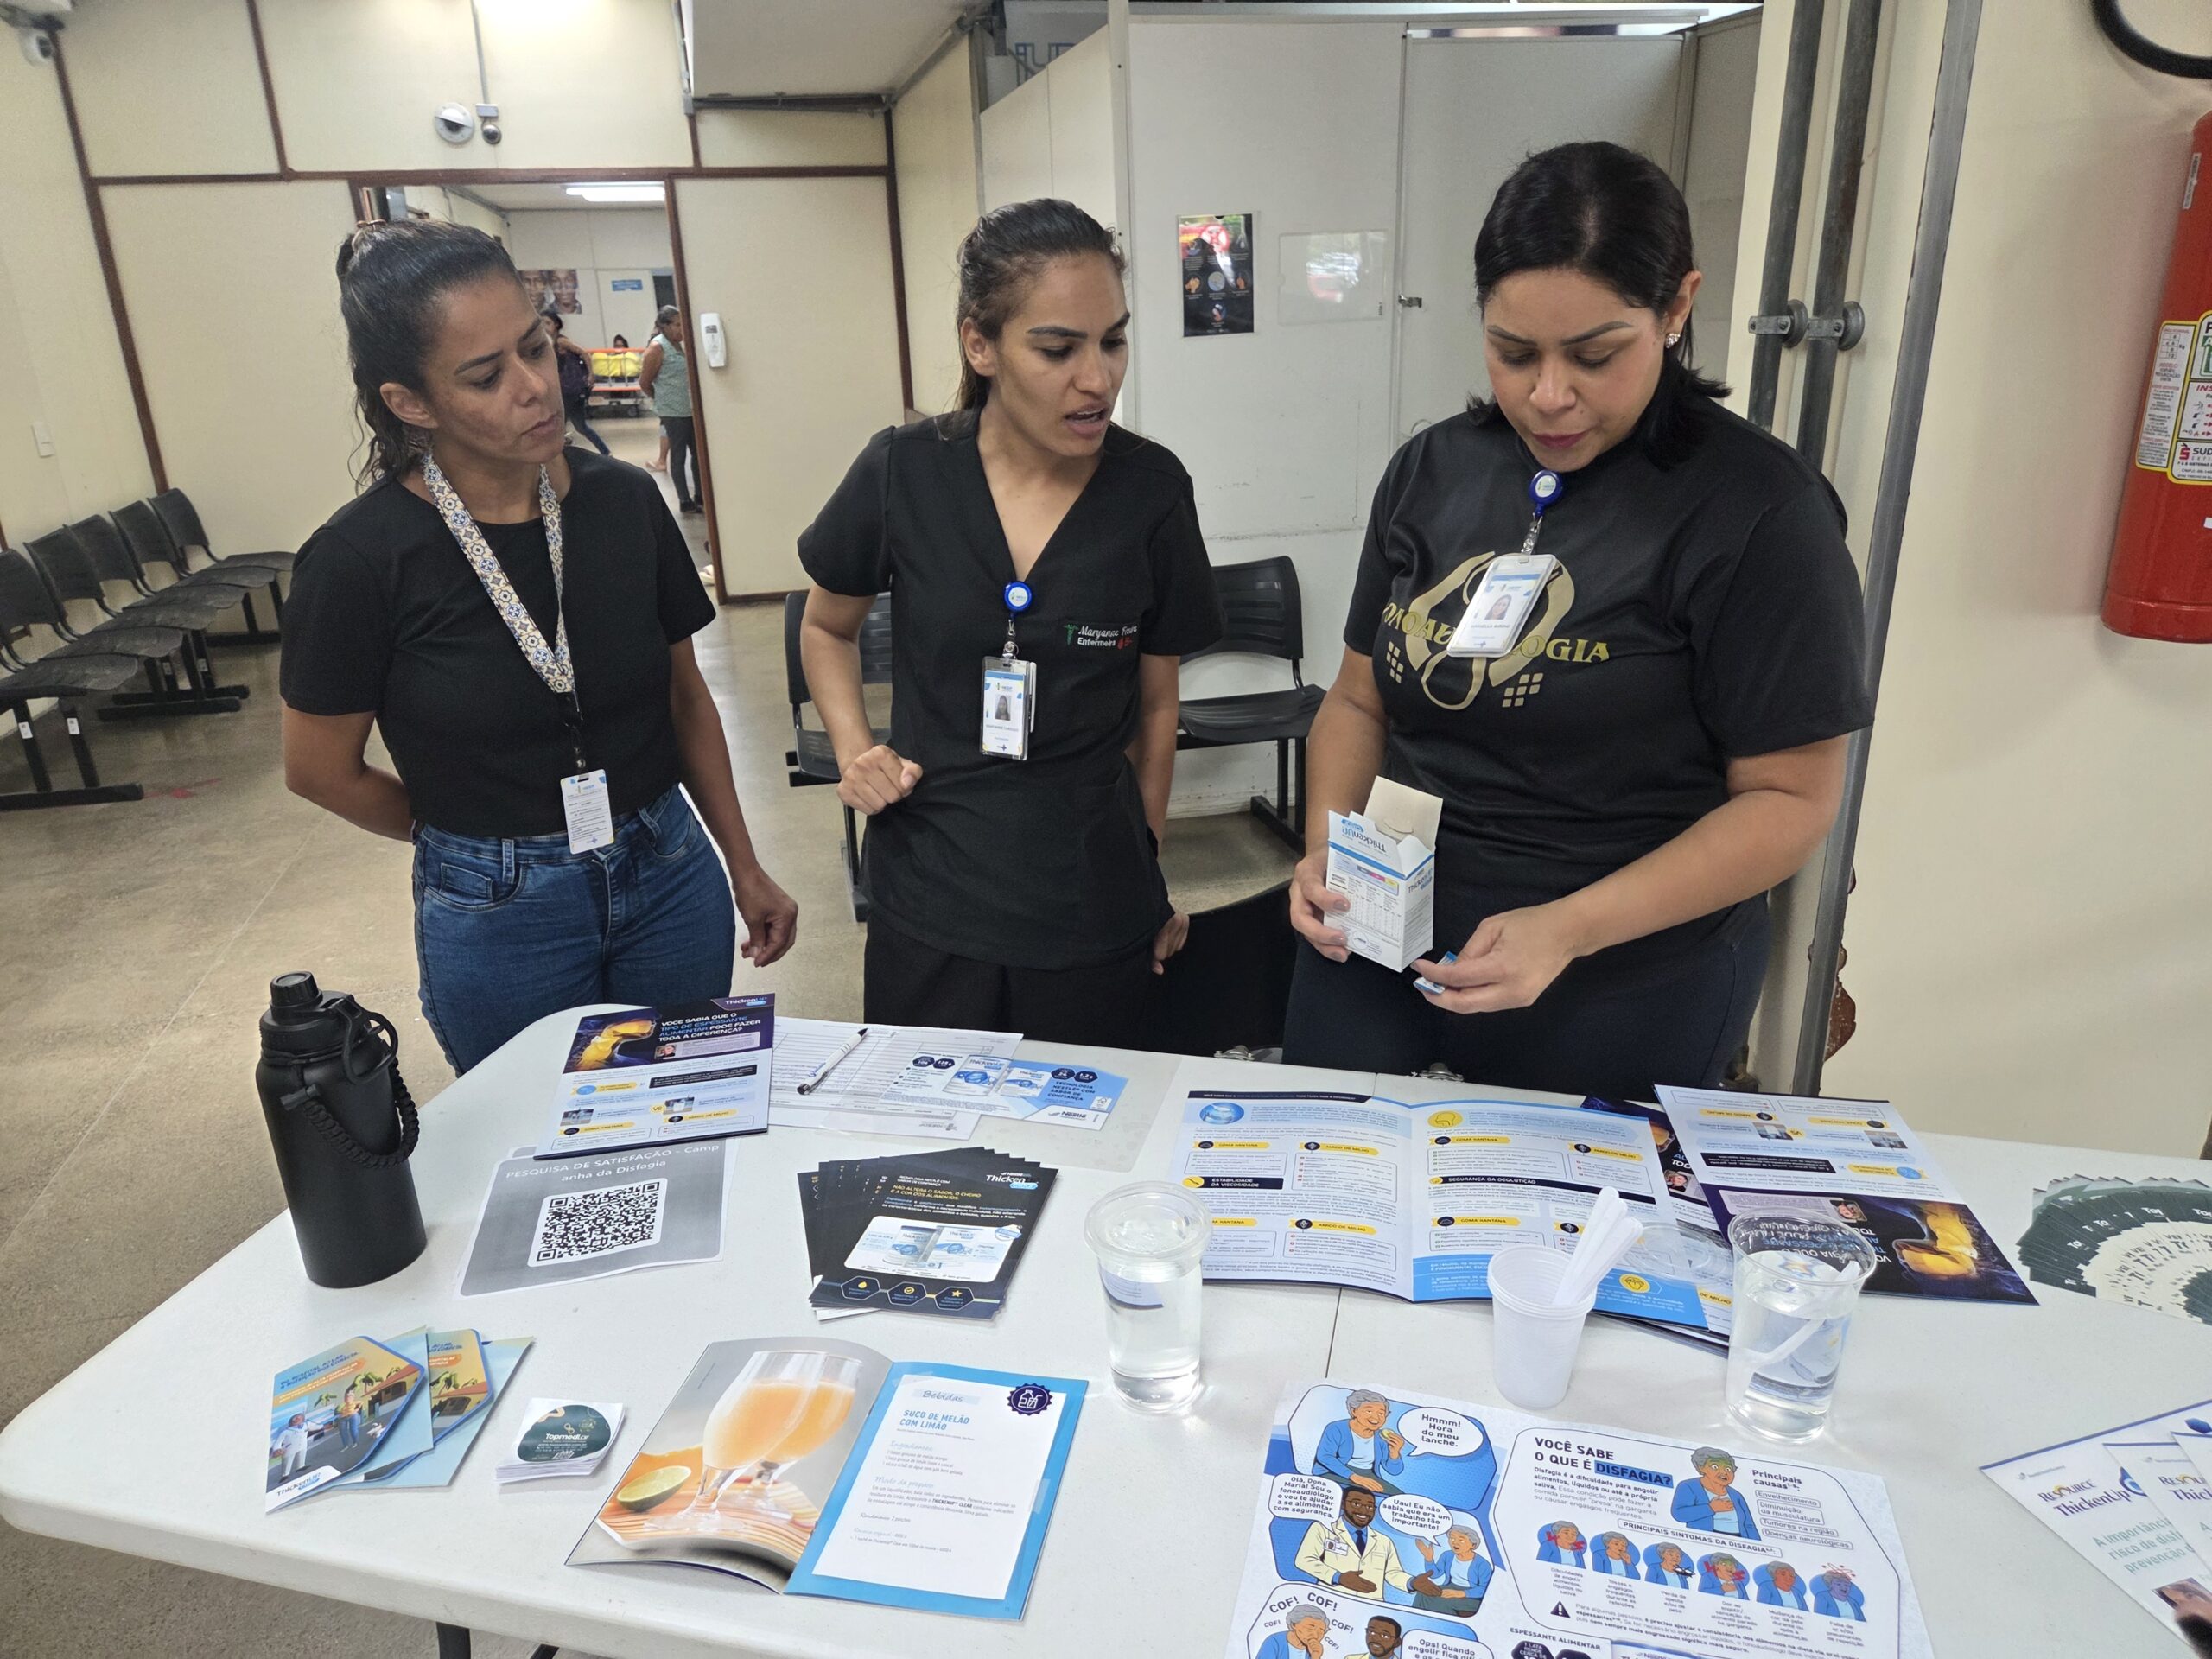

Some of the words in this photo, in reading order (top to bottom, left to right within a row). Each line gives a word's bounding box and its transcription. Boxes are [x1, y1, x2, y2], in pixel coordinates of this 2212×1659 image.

[694, 1016, 747, 1027] ESPESSANTE
[659, 1027, 708, 1036] ALIMENTAR
[691, 1027, 742, 1037] DIFERENÇA?
[506, 1166, 569, 1179] PESQUISA
[594, 1149, 671, 1167] SATISFAÇÃO
[684, 1144, 720, 1155] Camp
[562, 1173, 593, 1182] anha
[616, 1160, 666, 1174] Disfagia
[986, 1174, 1026, 1184] Thicken
[922, 1390, 963, 1402] Bebidas
[920, 1421, 947, 1430] LIMÃO
[941, 1414, 970, 1424] MELÃO
[1421, 1414, 1460, 1427] Hmmm!
[1429, 1423, 1452, 1433] Hora
[1421, 1435, 1459, 1446] lanche.
[1535, 1437, 1572, 1452] VOCÊ
[1577, 1445, 1614, 1460] SABE
[1535, 1452, 1544, 1461] O
[1549, 1454, 1579, 1467] QUE
[1584, 1459, 1592, 1470] É
[1596, 1463, 1671, 1485] DISFAGIA?
[1535, 1467, 1561, 1476] Disfagia
[1576, 1474, 1613, 1486] dificuldade
[1616, 1482, 1631, 1491] para
[1634, 1485, 1659, 1495] engolir
[1752, 1470, 1802, 1484] Principais
[1280, 1487, 1334, 1500] fonoaudiólogo
[1535, 1474, 1569, 1485] alimentos,
[1572, 1481, 1599, 1491] líquidos
[1631, 1492, 1658, 1503] própria
[1535, 1488, 1558, 1497] comida
[1625, 1504, 1657, 1516] garganta
[1576, 1490, 1606, 1500] condição
[1609, 1495, 1625, 1503] pode
[1758, 1491, 1817, 1506] Envelhecimento
[2053, 1489, 2132, 1517] ThickenUp
[1295, 1501, 1332, 1511] alimentar
[1570, 1501, 1603, 1512] engasgos
[1760, 1502, 1802, 1514] Diminuição
[1292, 1508, 1334, 1518] segurança.
[1392, 1511, 1426, 1521] trabalho
[1772, 1510, 1821, 1522] musculatura
[1392, 1517, 1440, 1530] importante!
[1764, 1519, 1796, 1529] Tumores
[1810, 1527, 1834, 1536] região
[1623, 1521, 1669, 1535] PRINCIPAIS
[1671, 1530, 1713, 1543] SINTOMAS
[1765, 1529, 1797, 1541] Doenças
[1799, 1535, 1849, 1548] neurológicas
[2093, 1536, 2107, 1548] A
[2108, 1545, 2141, 1560] risco
[2140, 1540, 2157, 1549] de
[2124, 1548, 2186, 1574] prevenção
[1269, 1596, 1299, 1613] COF!
[1307, 1592, 1338, 1611] COF!
[1332, 1619, 1354, 1634] COF!
[1325, 1637, 1339, 1649] COF!
[1510, 1627, 1556, 1642] ESPESSANTE
[1559, 1637, 1601, 1650] ALIMENTAR
[1408, 1645, 1440, 1655] engolir
[1420, 1639, 1439, 1649] Ops!
[1442, 1643, 1475, 1656] Quando
